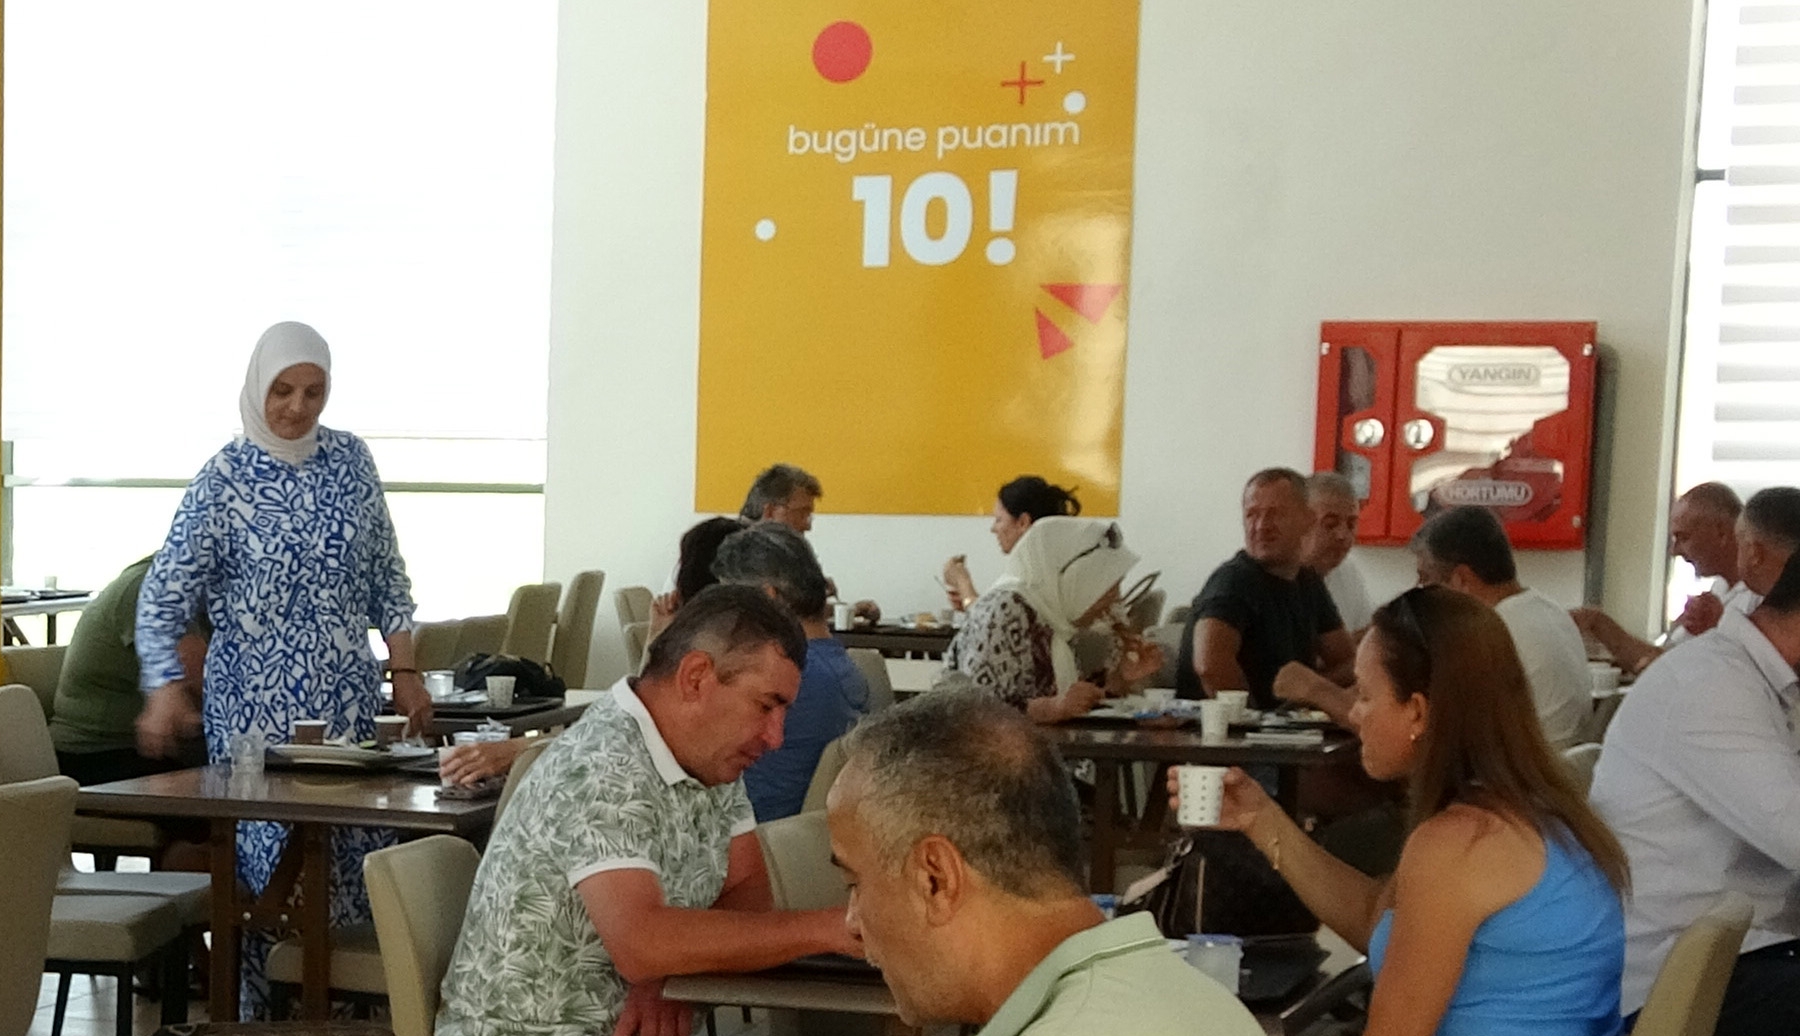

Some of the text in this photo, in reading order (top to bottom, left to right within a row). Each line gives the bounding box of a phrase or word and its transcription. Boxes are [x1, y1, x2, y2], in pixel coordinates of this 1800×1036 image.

[788, 120, 1080, 163] bugüne puanım
[852, 168, 1018, 268] 10!
